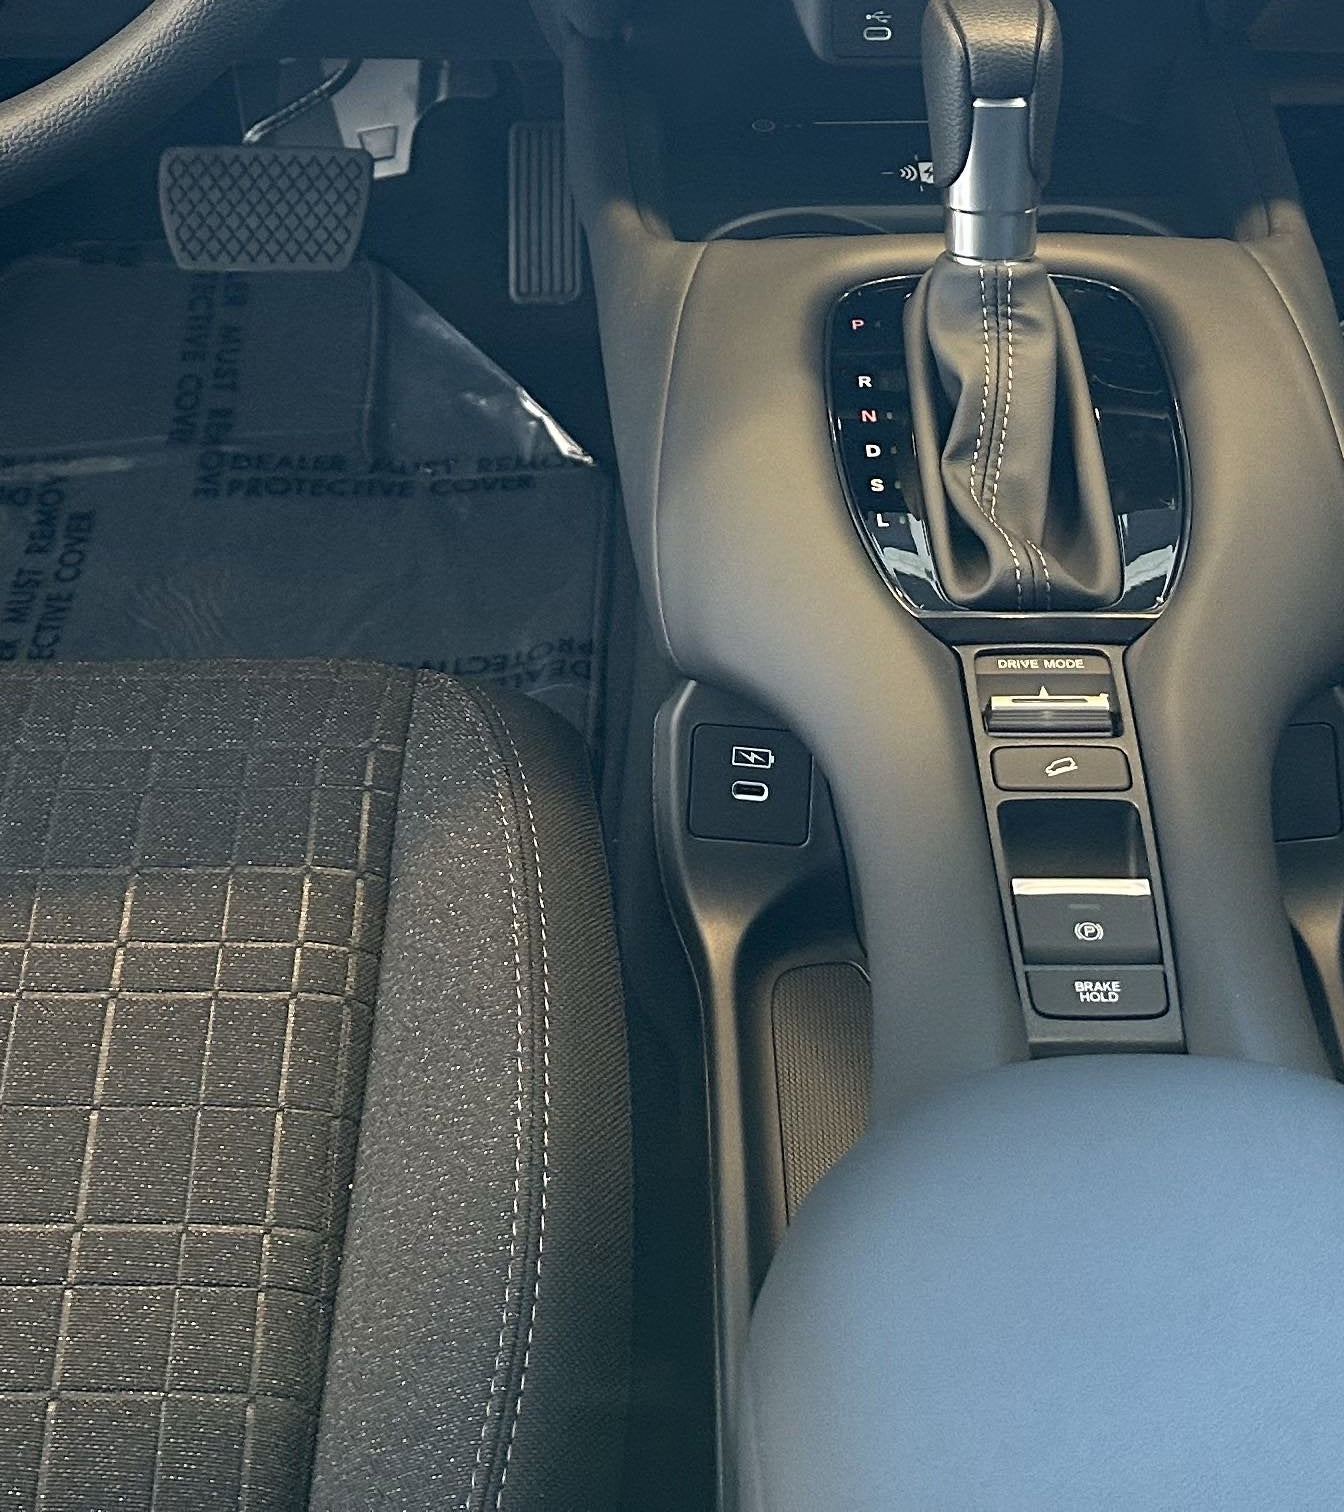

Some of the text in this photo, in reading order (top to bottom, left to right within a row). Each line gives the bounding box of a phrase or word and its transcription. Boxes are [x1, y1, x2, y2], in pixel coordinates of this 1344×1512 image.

[852, 318, 865, 330] P
[858, 375, 872, 388] R
[861, 409, 877, 423] N
[866, 444, 882, 458] D
[227, 475, 535, 498] PROTECTIVE COVER
[870, 478, 885, 492] S
[876, 513, 890, 528] L
[997, 659, 1085, 669] DRIVE MODE
[1074, 981, 1121, 992] BRAKE
[1079, 991, 1119, 1002] HOLD
